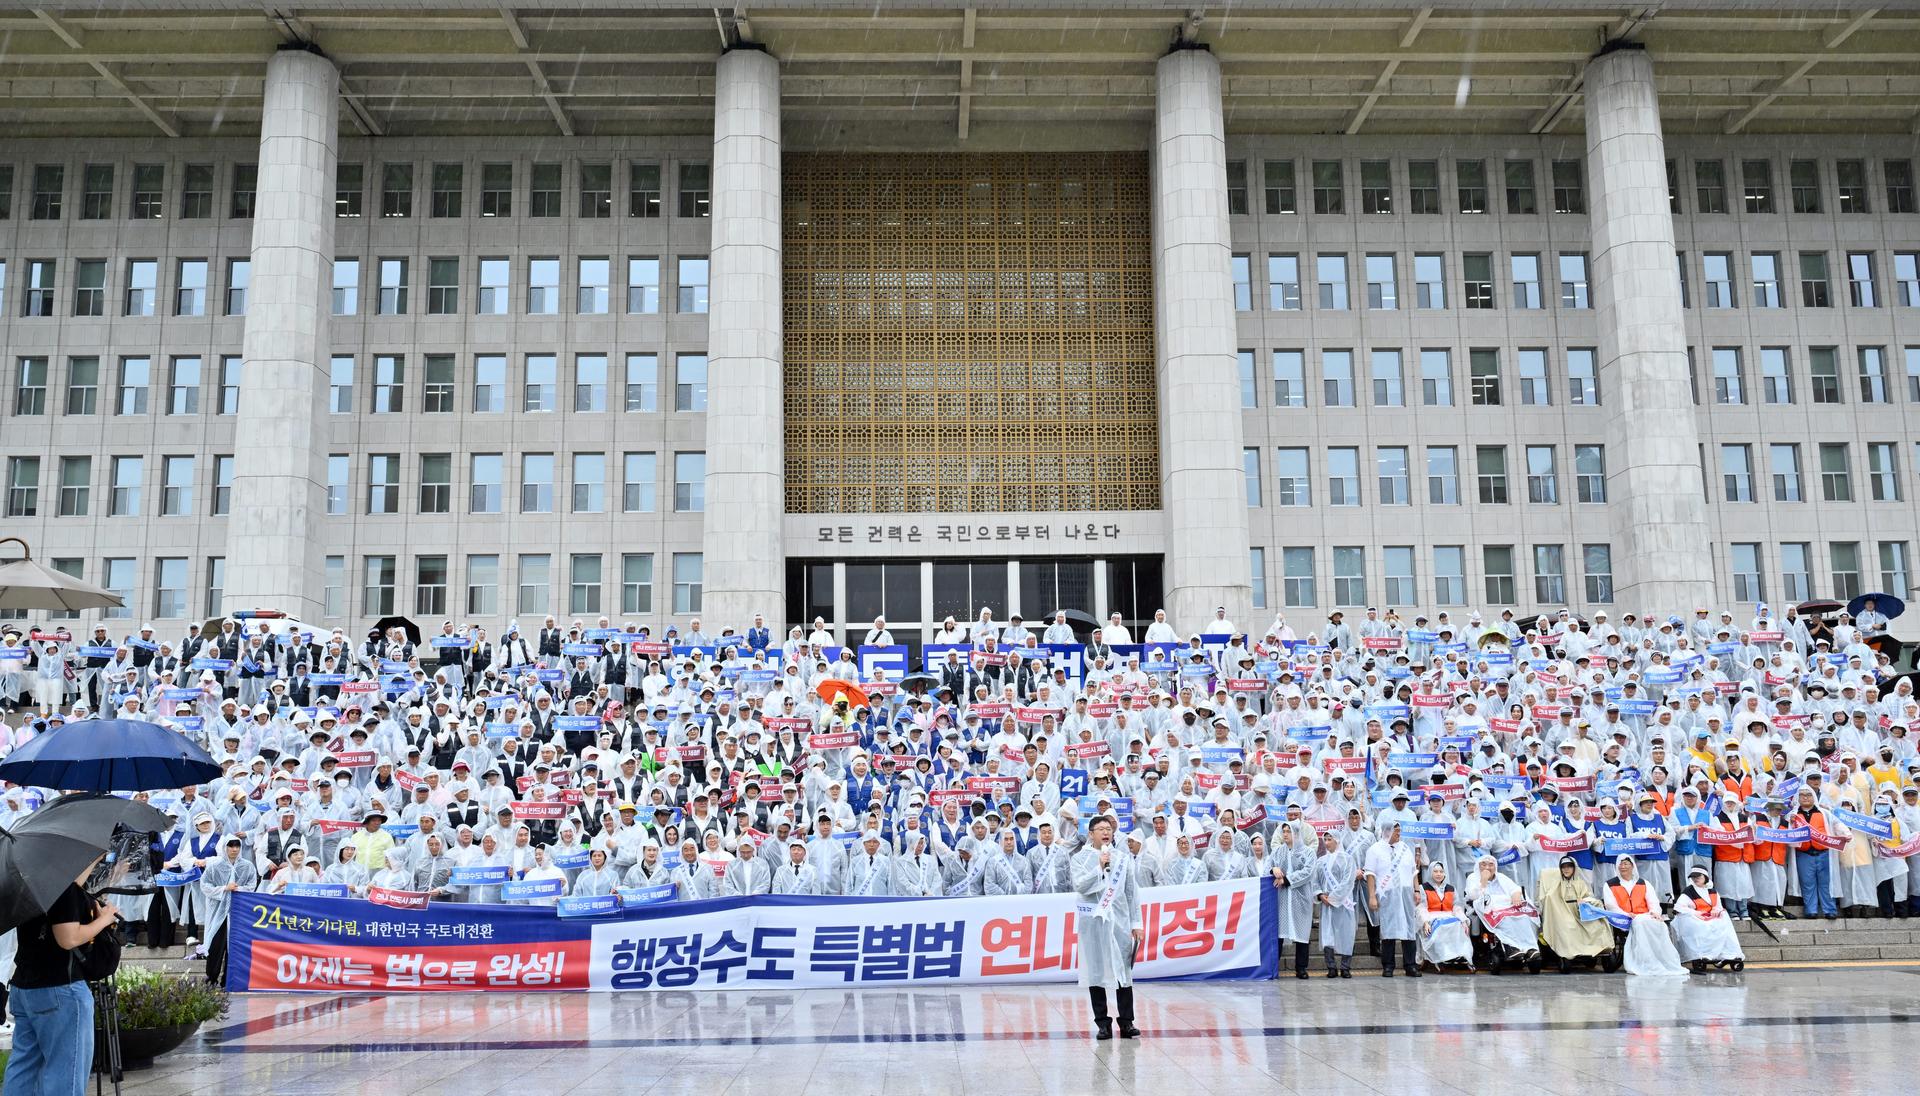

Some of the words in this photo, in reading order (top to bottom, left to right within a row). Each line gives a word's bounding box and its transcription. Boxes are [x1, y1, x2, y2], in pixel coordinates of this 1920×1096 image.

[818, 526, 853, 542] 모든
[868, 525, 922, 543] 권력은
[937, 524, 1050, 542] 국민으로부터
[1065, 523, 1121, 540] 나온다
[1062, 776, 1083, 793] 21
[515, 806, 527, 814] 연내
[529, 806, 546, 815] 반드시
[548, 807, 562, 815] 제정!
[456, 872, 482, 880] 행정수도
[484, 872, 504, 880] 특별법!
[534, 883, 556, 892] 특별법!
[391, 895, 408, 904] 반드시
[409, 897, 424, 905] 제정!
[592, 900, 613, 909] 특별법!
[252, 904, 313, 933] 24년간
[317, 920, 361, 937] 기다림,
[366, 922, 419, 939] 대한민국
[424, 923, 494, 940] 국토대전환
[610, 927, 797, 990] 행정수도
[809, 920, 965, 982] 특별법
[276, 952, 375, 986] 이제는
[385, 952, 477, 987] 법으로
[486, 951, 565, 984] 완성!
